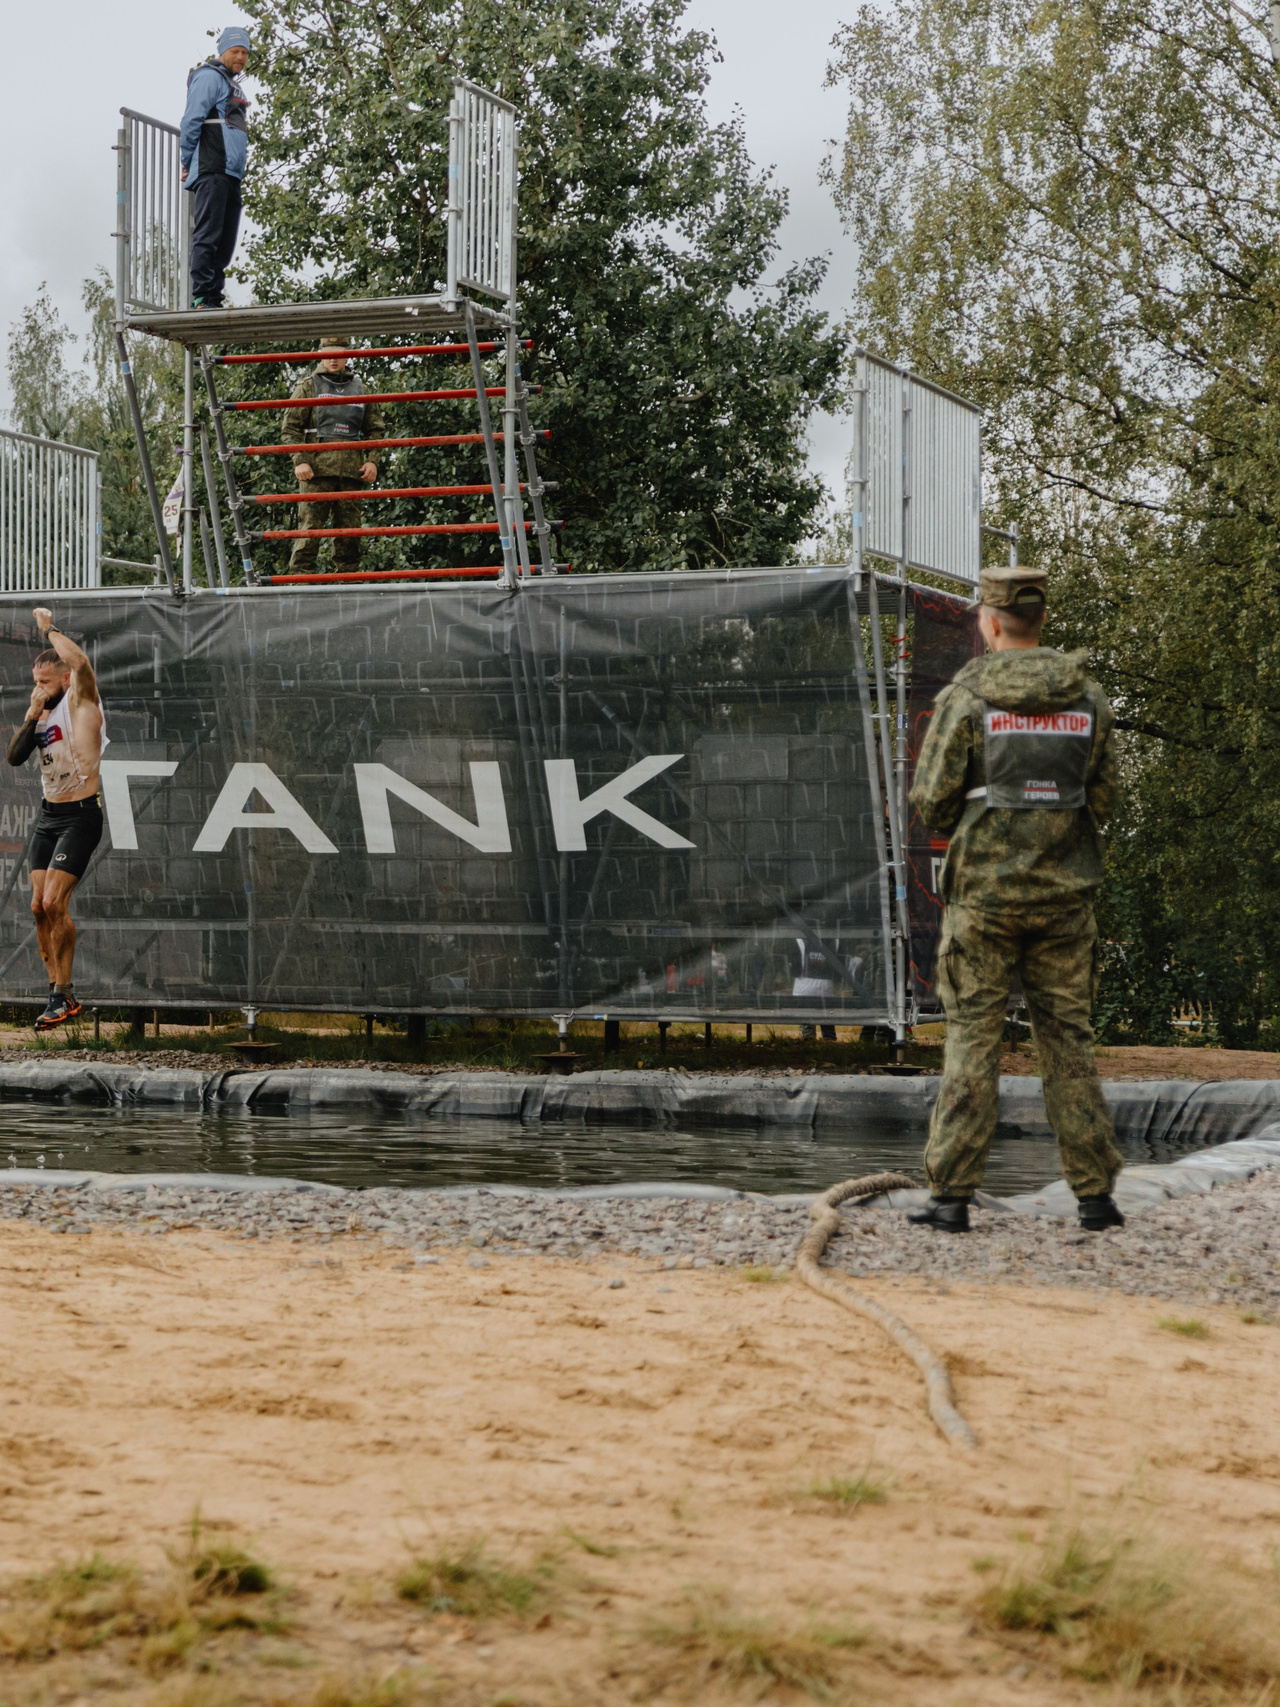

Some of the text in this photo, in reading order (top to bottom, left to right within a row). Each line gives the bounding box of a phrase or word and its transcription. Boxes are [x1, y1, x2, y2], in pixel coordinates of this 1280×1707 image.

[164, 504, 178, 518] 25
[990, 713, 1089, 732] ИНСТРУКТОР
[1026, 780, 1057, 788] ГОНКА
[1024, 792, 1060, 800] ГЕРОЕВ
[100, 754, 697, 854] TANK
